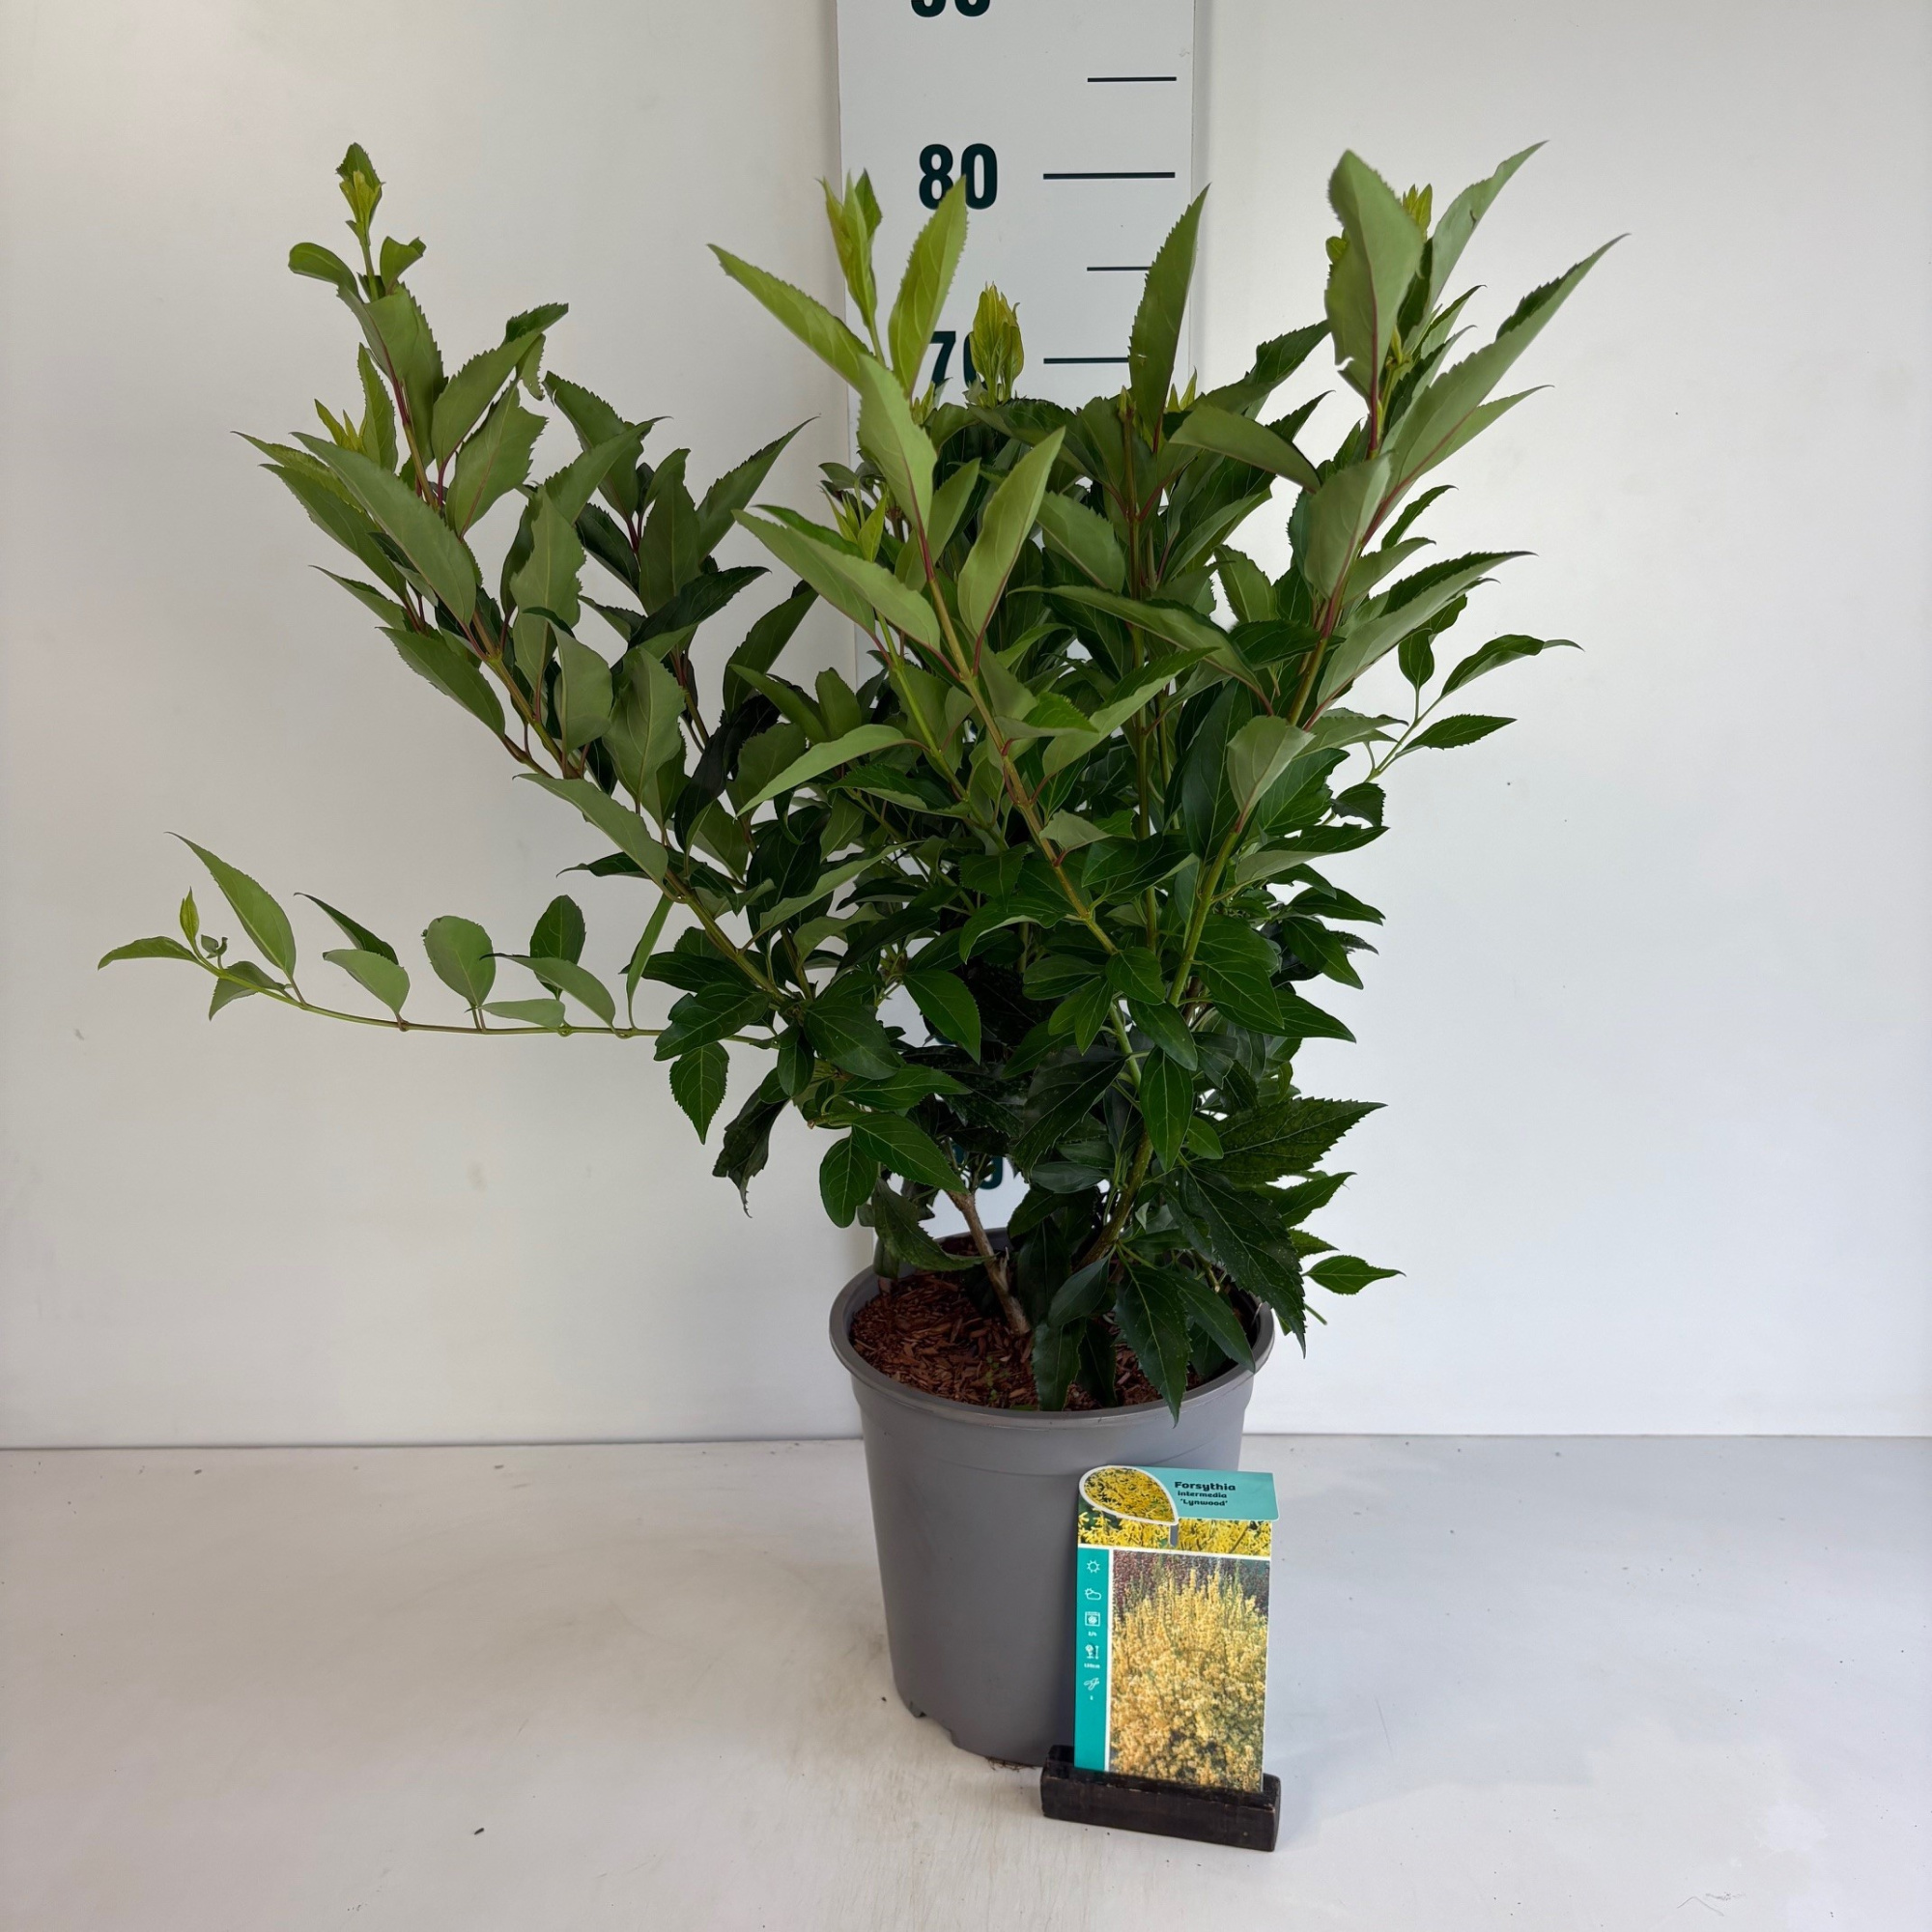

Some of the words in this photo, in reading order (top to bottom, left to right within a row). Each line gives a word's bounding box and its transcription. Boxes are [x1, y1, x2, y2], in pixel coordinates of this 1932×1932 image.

[919, 143, 998, 211] 80
[1174, 1481, 1236, 1492] Forsythia
[1177, 1490, 1228, 1498] intermedia
